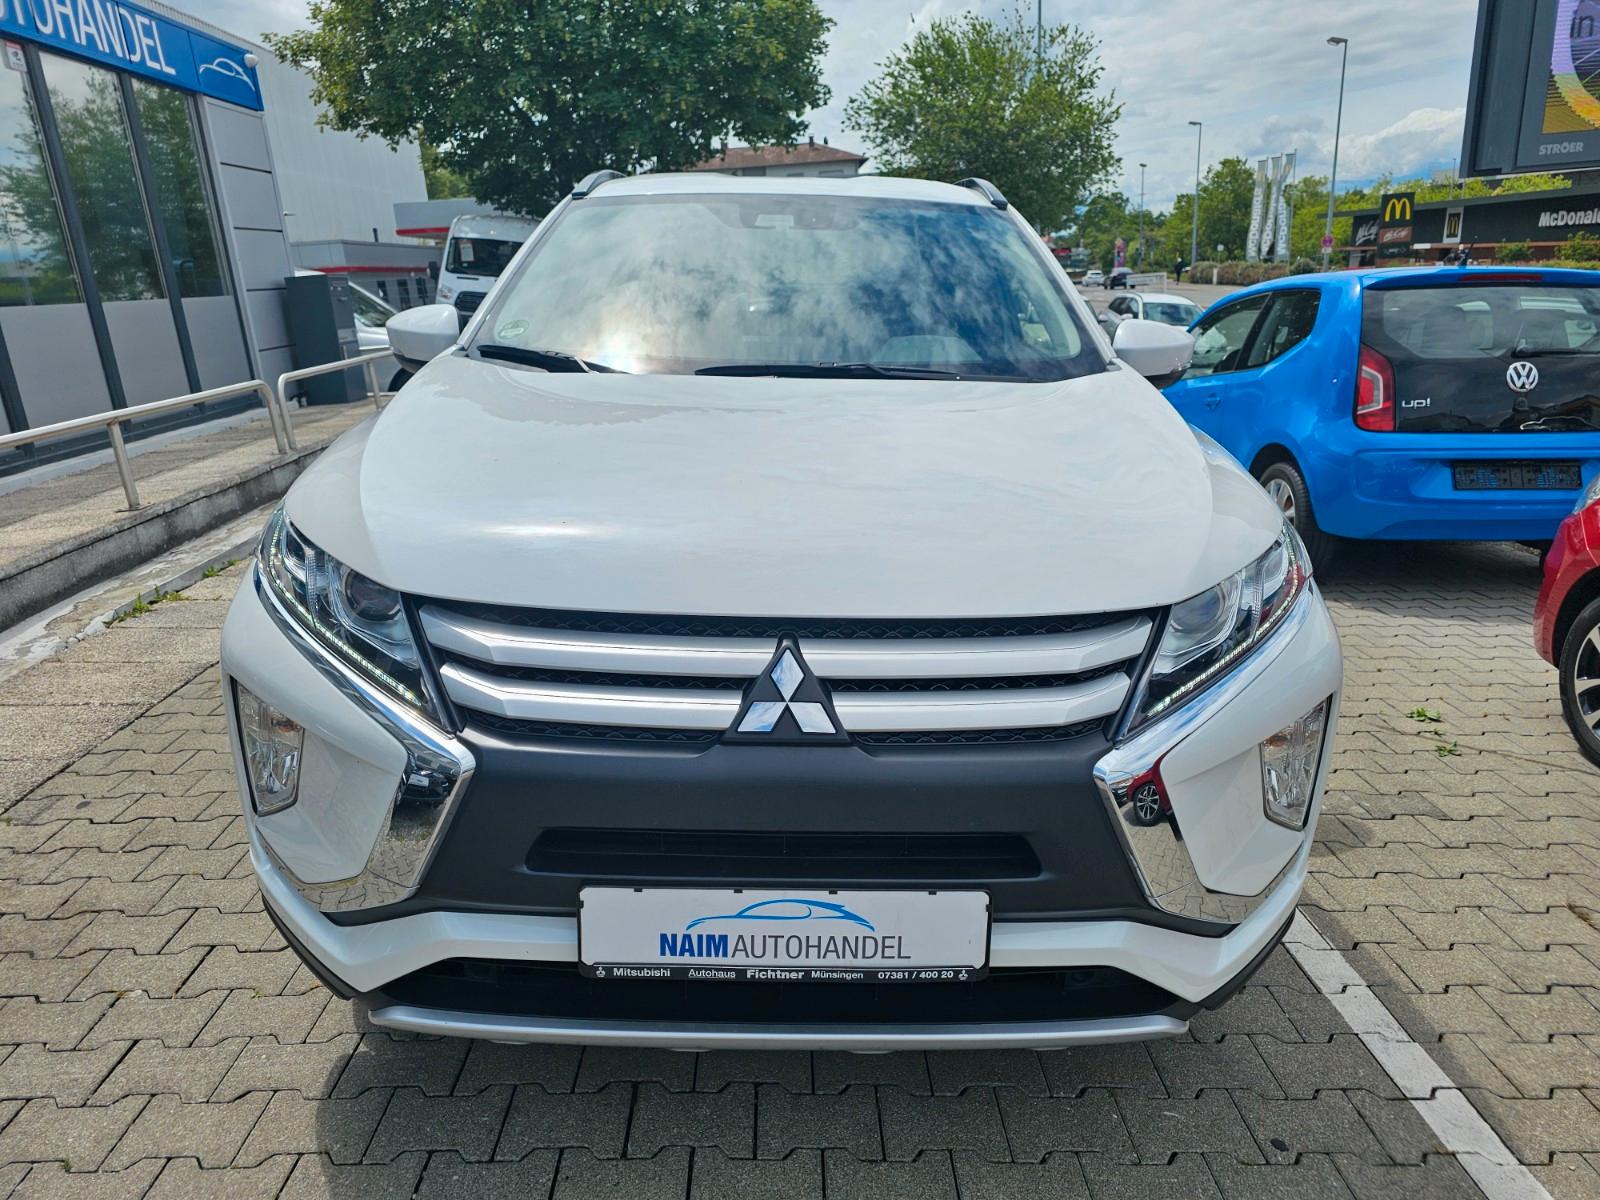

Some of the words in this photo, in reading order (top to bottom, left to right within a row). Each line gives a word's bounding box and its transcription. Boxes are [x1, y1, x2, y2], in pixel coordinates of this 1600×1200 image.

[0, 0, 176, 75] OHANDEL
[1539, 142, 1584, 155] STRÖER
[1402, 398, 1430, 408] up!
[659, 933, 728, 958] NAIM
[731, 934, 911, 960] AUTOHANDEL
[613, 967, 671, 977] Mitsubishi
[688, 969, 736, 979] Autohaus
[746, 969, 805, 980] Fichtner
[811, 970, 864, 980] Münsingen
[878, 970, 909, 979] 07381
[919, 970, 938, 979] 400
[940, 970, 954, 978] 20
